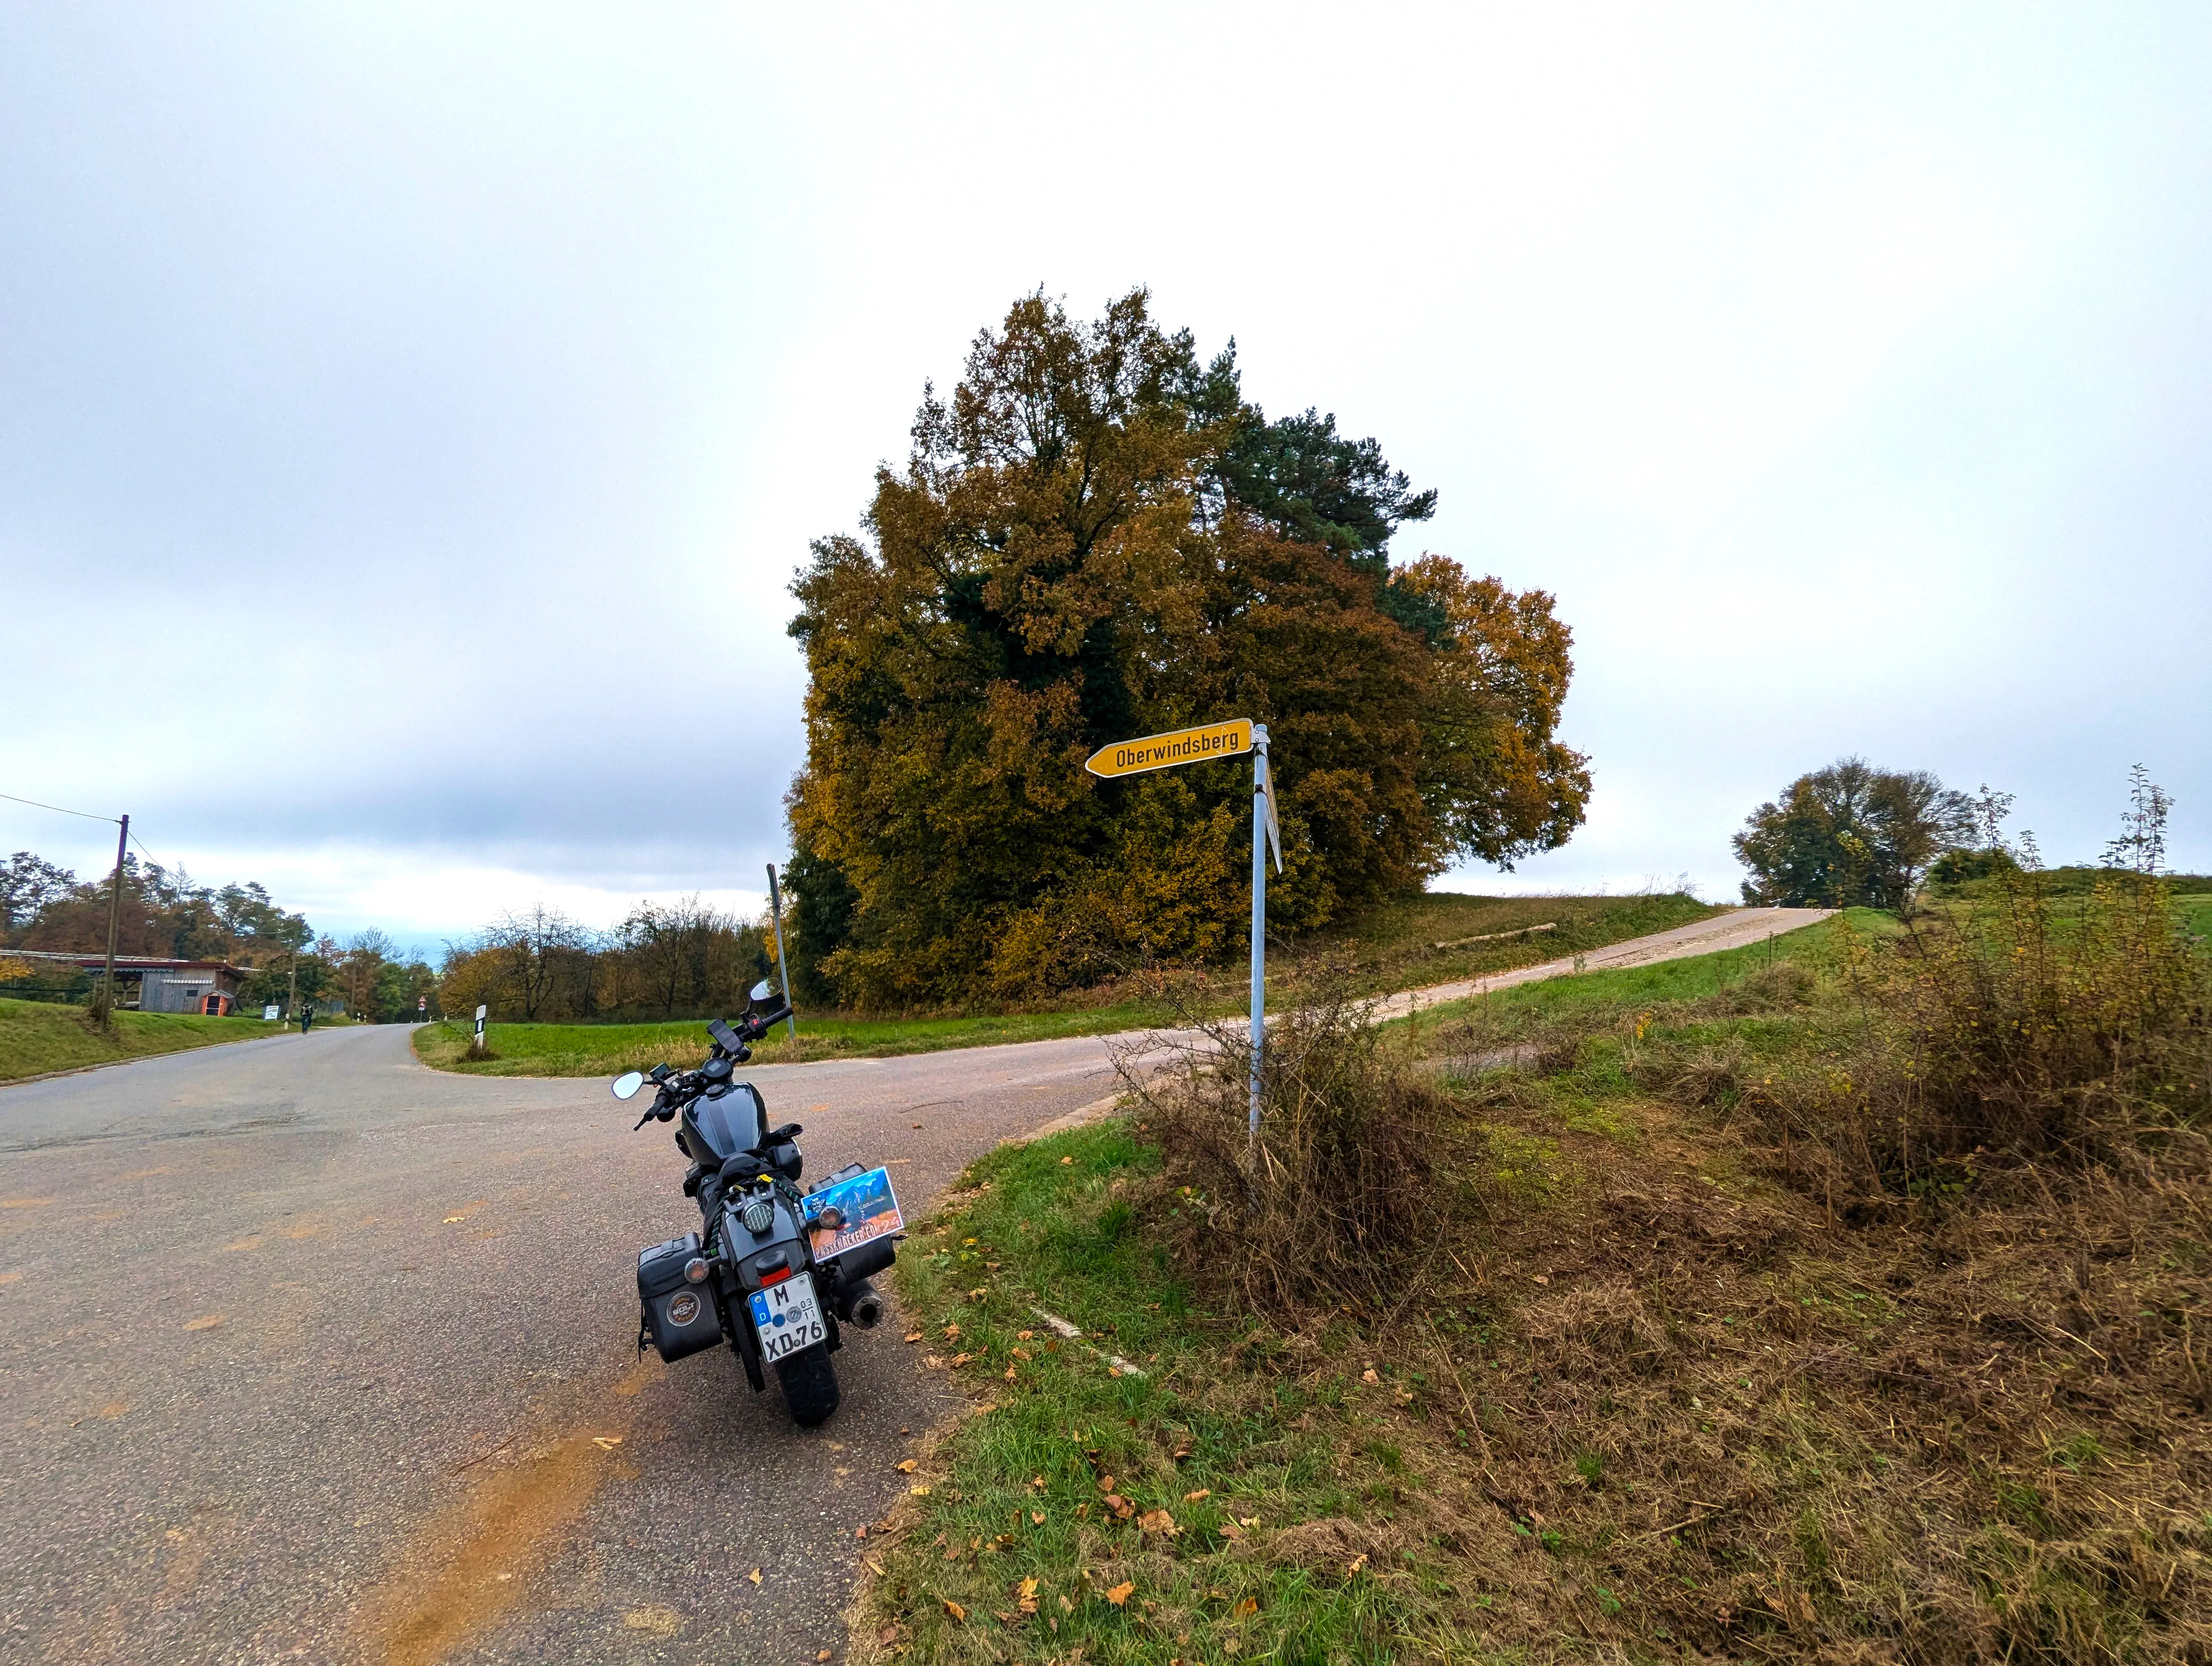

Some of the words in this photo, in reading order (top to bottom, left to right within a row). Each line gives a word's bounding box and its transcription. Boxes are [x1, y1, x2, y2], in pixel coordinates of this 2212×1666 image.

[1117, 732, 1238, 767] Oberwindsberg
[815, 1225, 881, 1258] PASSKNACKER.COM
[774, 1285, 789, 1306] M
[673, 1302, 695, 1315] BOLT
[800, 1298, 812, 1309] 03
[760, 1312, 766, 1321] D
[804, 1310, 815, 1319] 11
